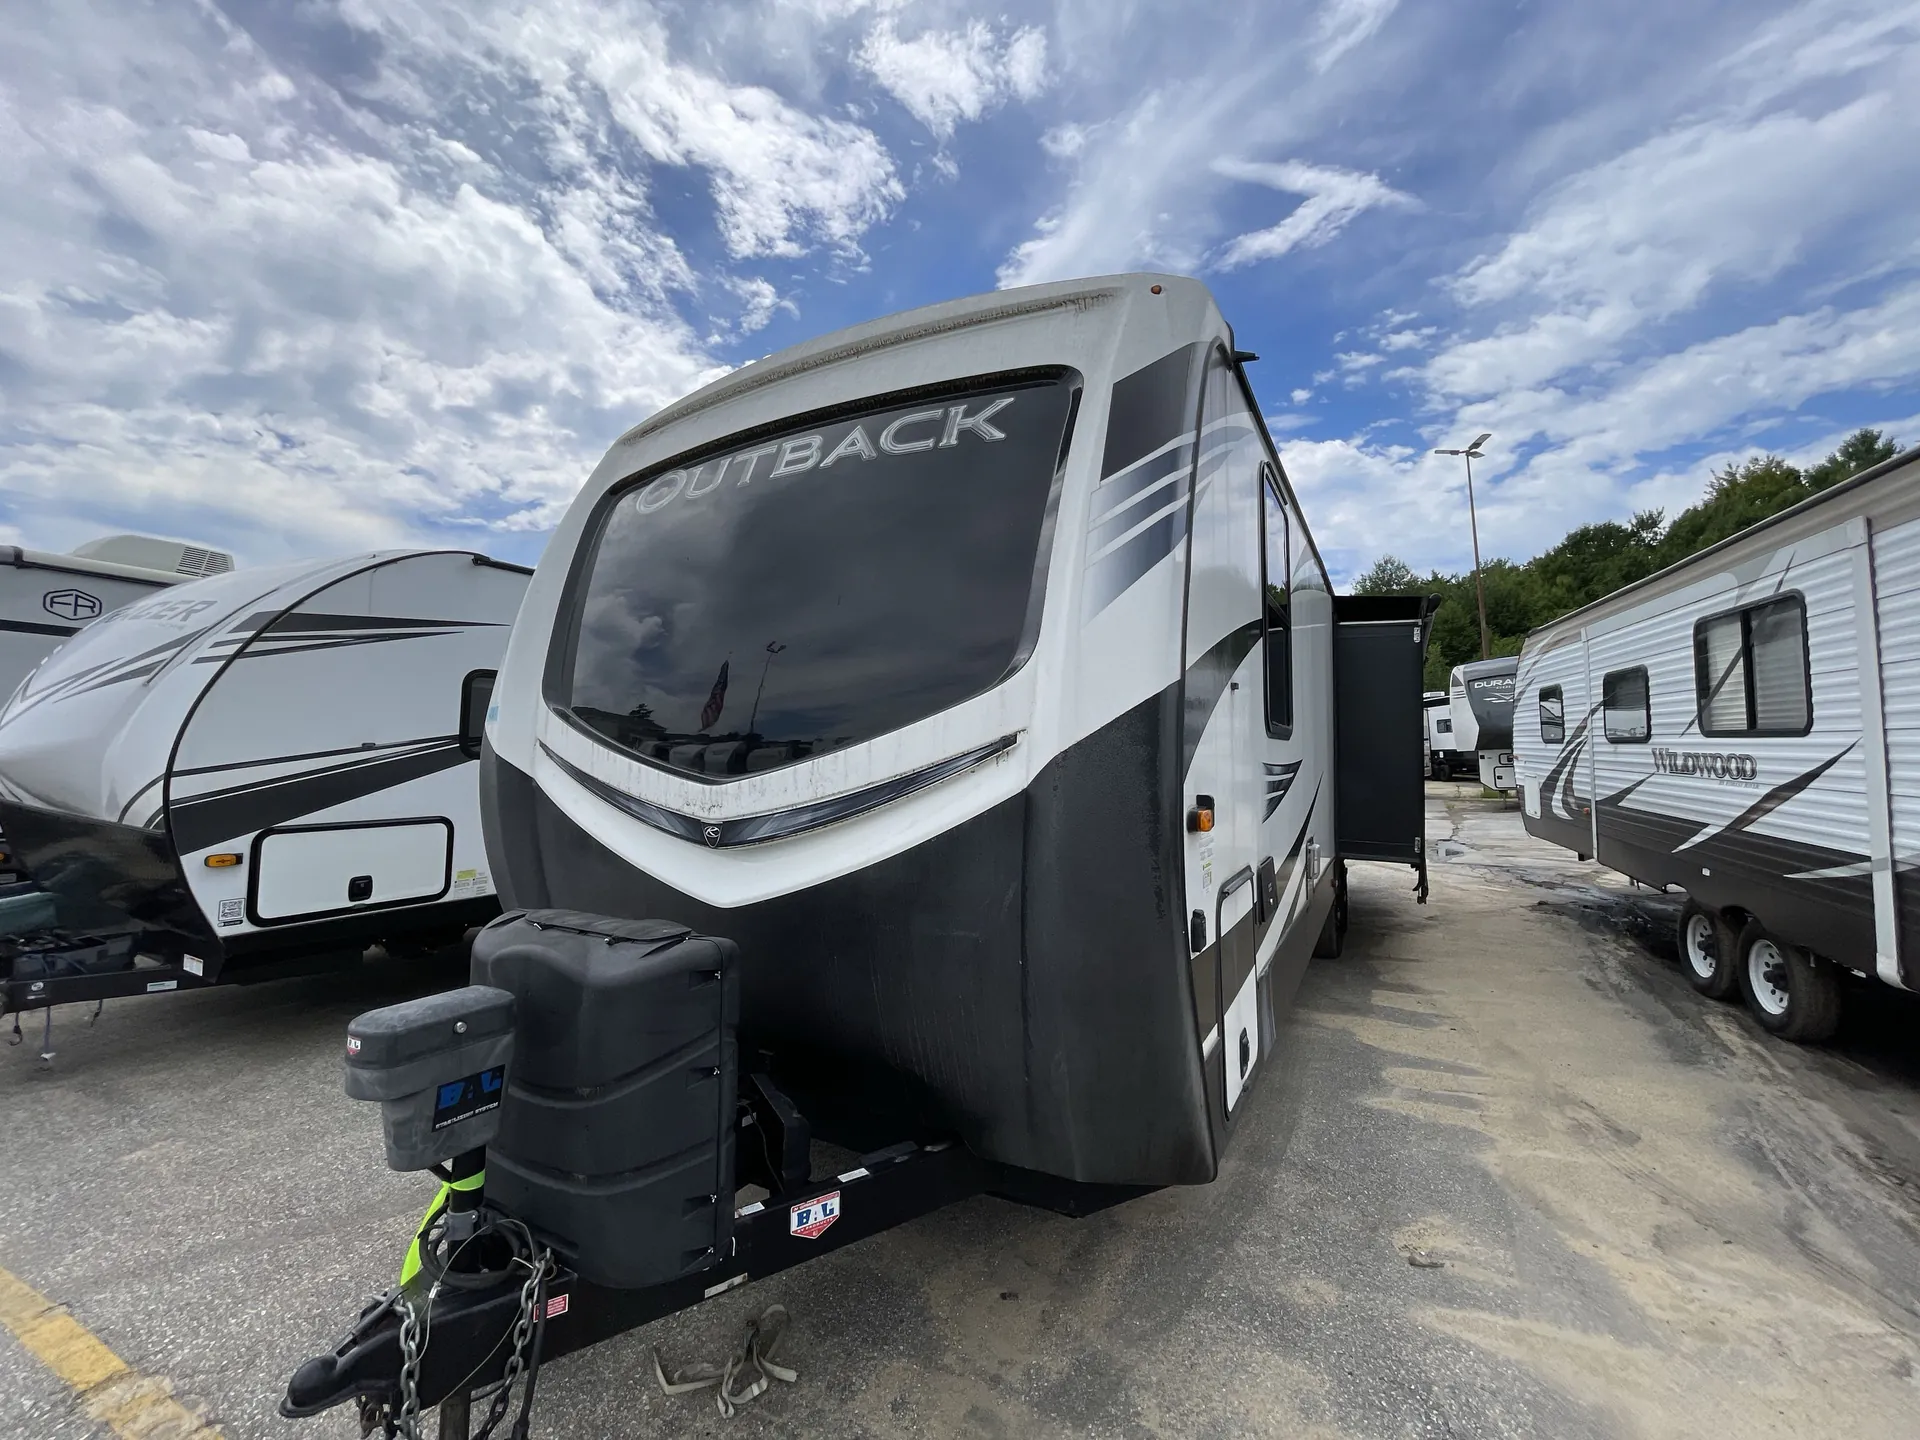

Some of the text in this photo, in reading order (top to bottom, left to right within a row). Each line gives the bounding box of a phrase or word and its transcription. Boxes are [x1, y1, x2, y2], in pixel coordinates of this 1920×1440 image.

[635, 397, 1015, 514] OUTBACK
[50, 593, 96, 617] FR
[1651, 747, 1758, 781] WILDWOOD
